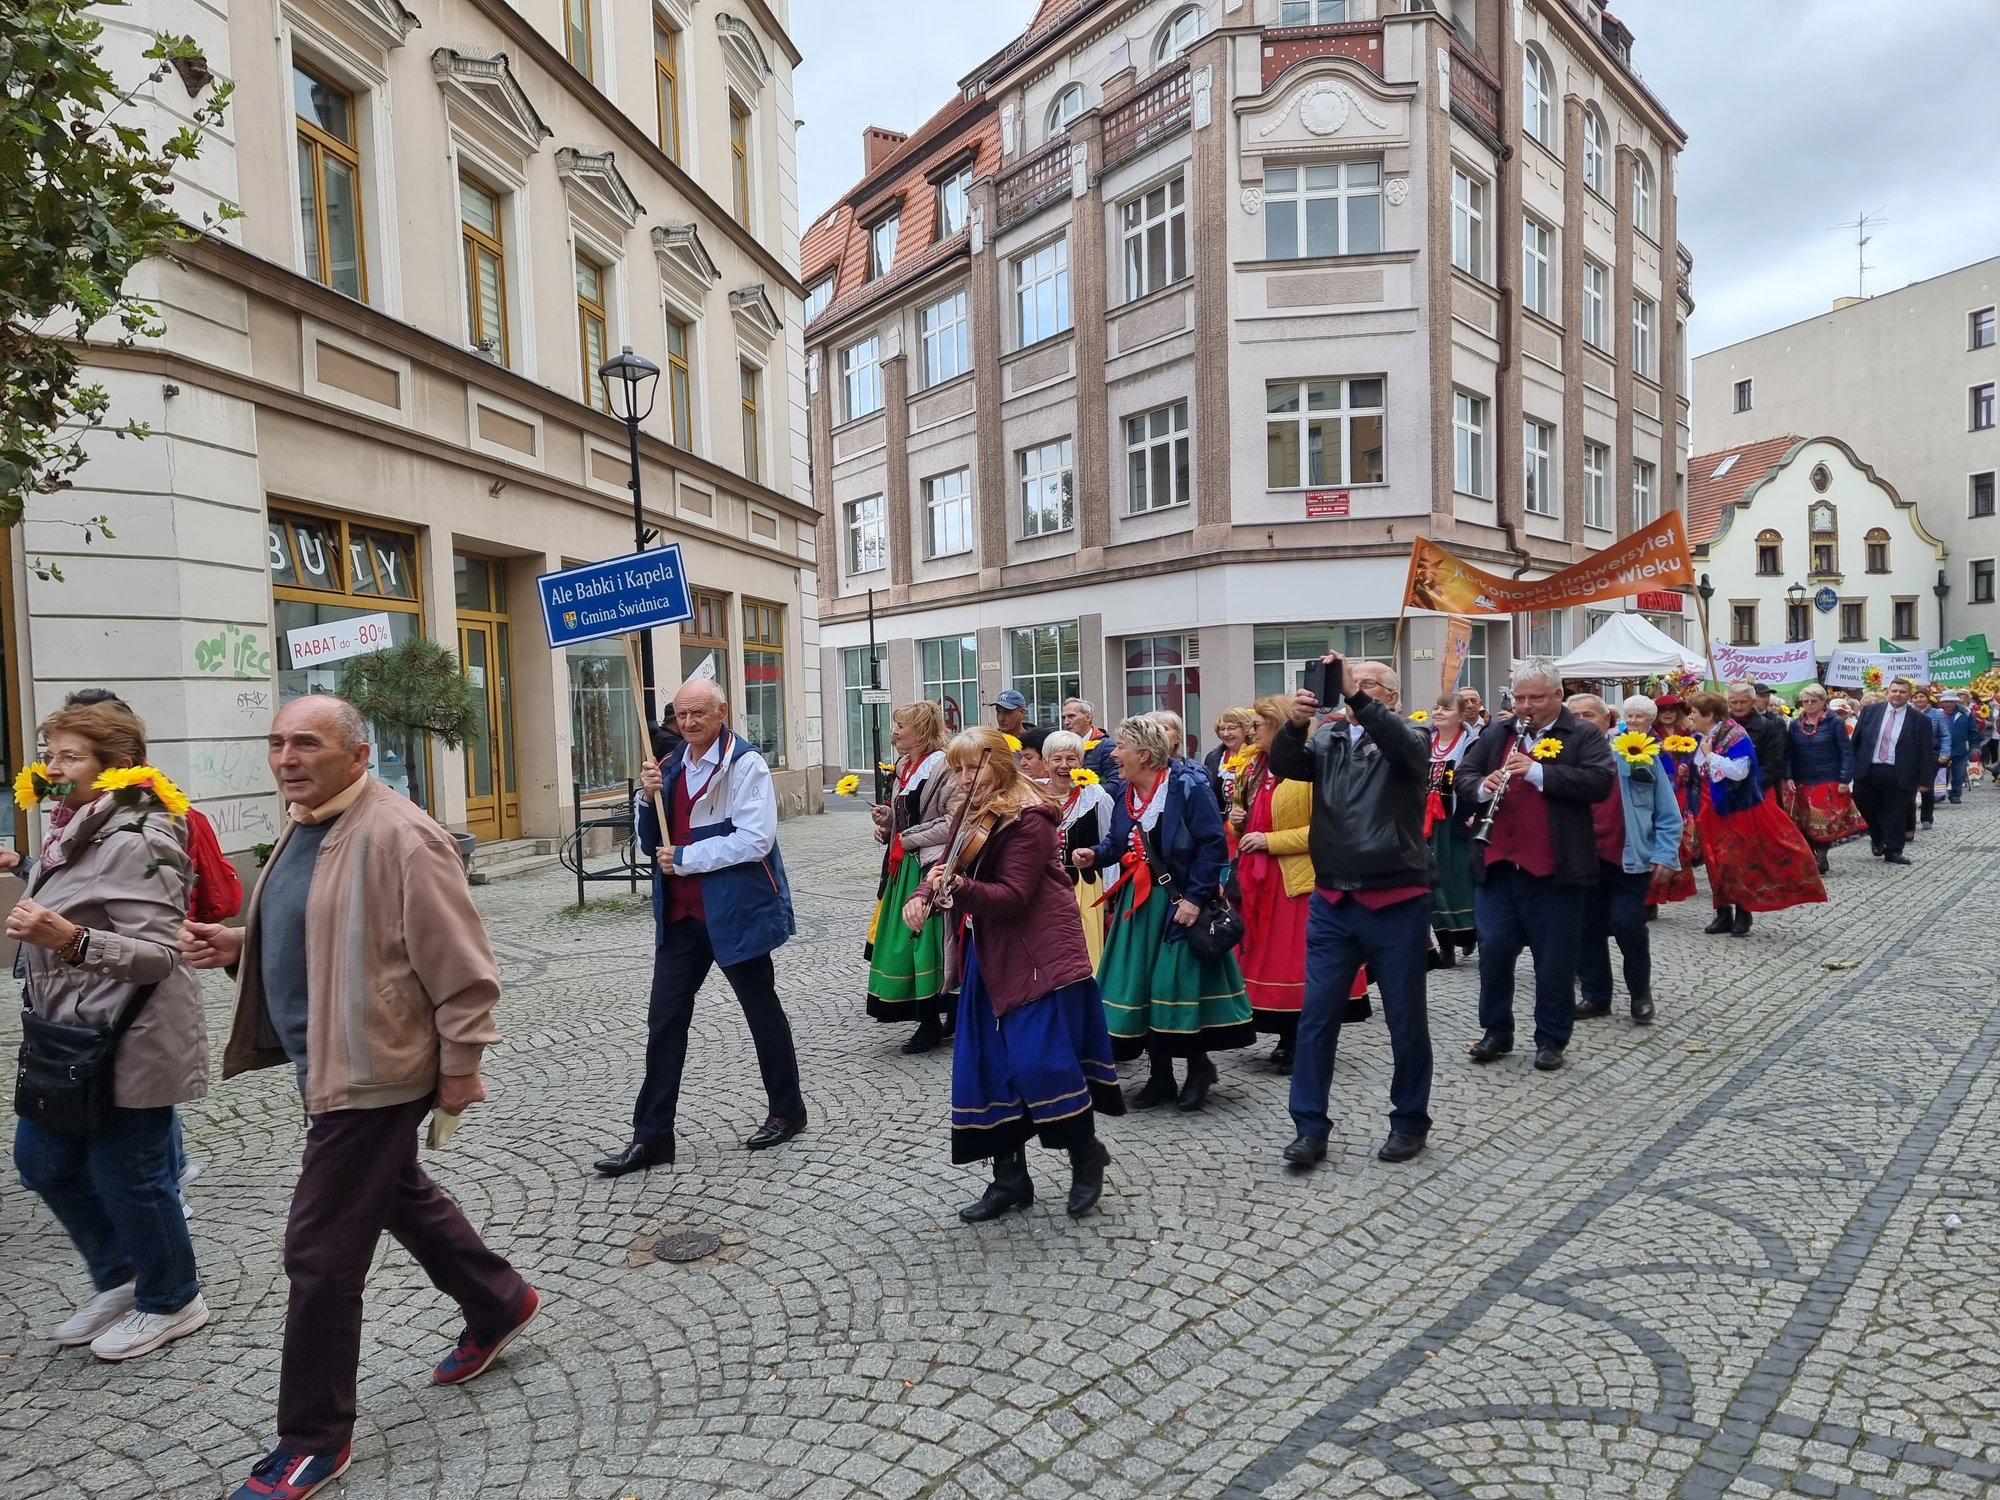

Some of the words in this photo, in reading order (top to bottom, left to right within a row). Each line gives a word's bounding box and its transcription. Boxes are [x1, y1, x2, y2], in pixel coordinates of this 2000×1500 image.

[268, 530, 397, 586] BUTY
[1454, 564, 1553, 600] Karkonoski
[1559, 528, 1675, 588] Uniwersytet
[1616, 557, 1681, 585] Wieku
[551, 586, 573, 606] Ale
[575, 575, 615, 600] Babki
[617, 573, 623, 591] i
[625, 562, 674, 590] Kapela
[580, 608, 618, 626] Gmina
[618, 596, 670, 618] Świdnica
[293, 635, 336, 659] RABAT
[339, 639, 351, 650] do
[353, 624, 387, 645] -80%
[1713, 648, 1808, 664] Kowarskie
[1928, 654, 1976, 669] ENIORÓW
